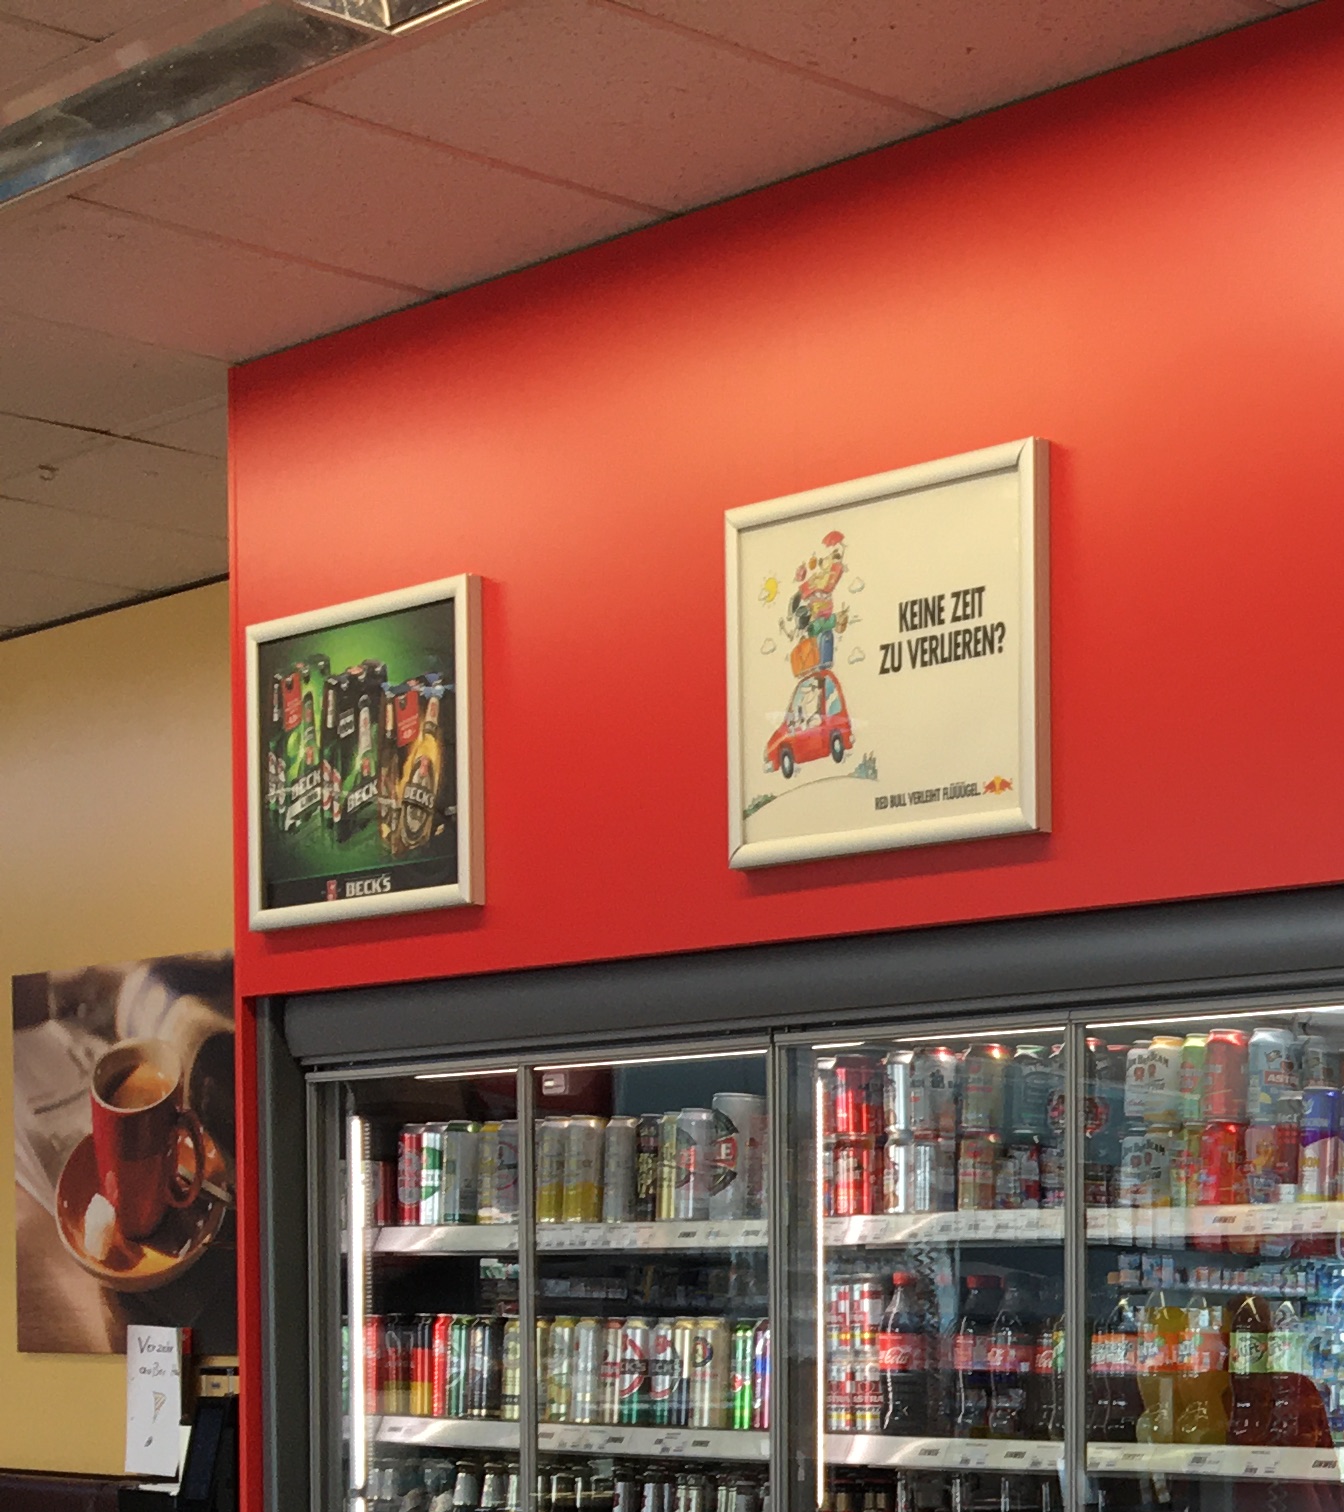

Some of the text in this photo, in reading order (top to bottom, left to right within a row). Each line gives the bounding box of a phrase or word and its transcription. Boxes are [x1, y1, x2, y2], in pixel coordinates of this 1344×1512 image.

[898, 586, 985, 633] KEINE ZEIT
[879, 621, 1006, 675] ZU VERLIEREN?
[875, 796, 888, 810] RED
[890, 793, 906, 808] BULL
[345, 876, 391, 897] BECK'S
